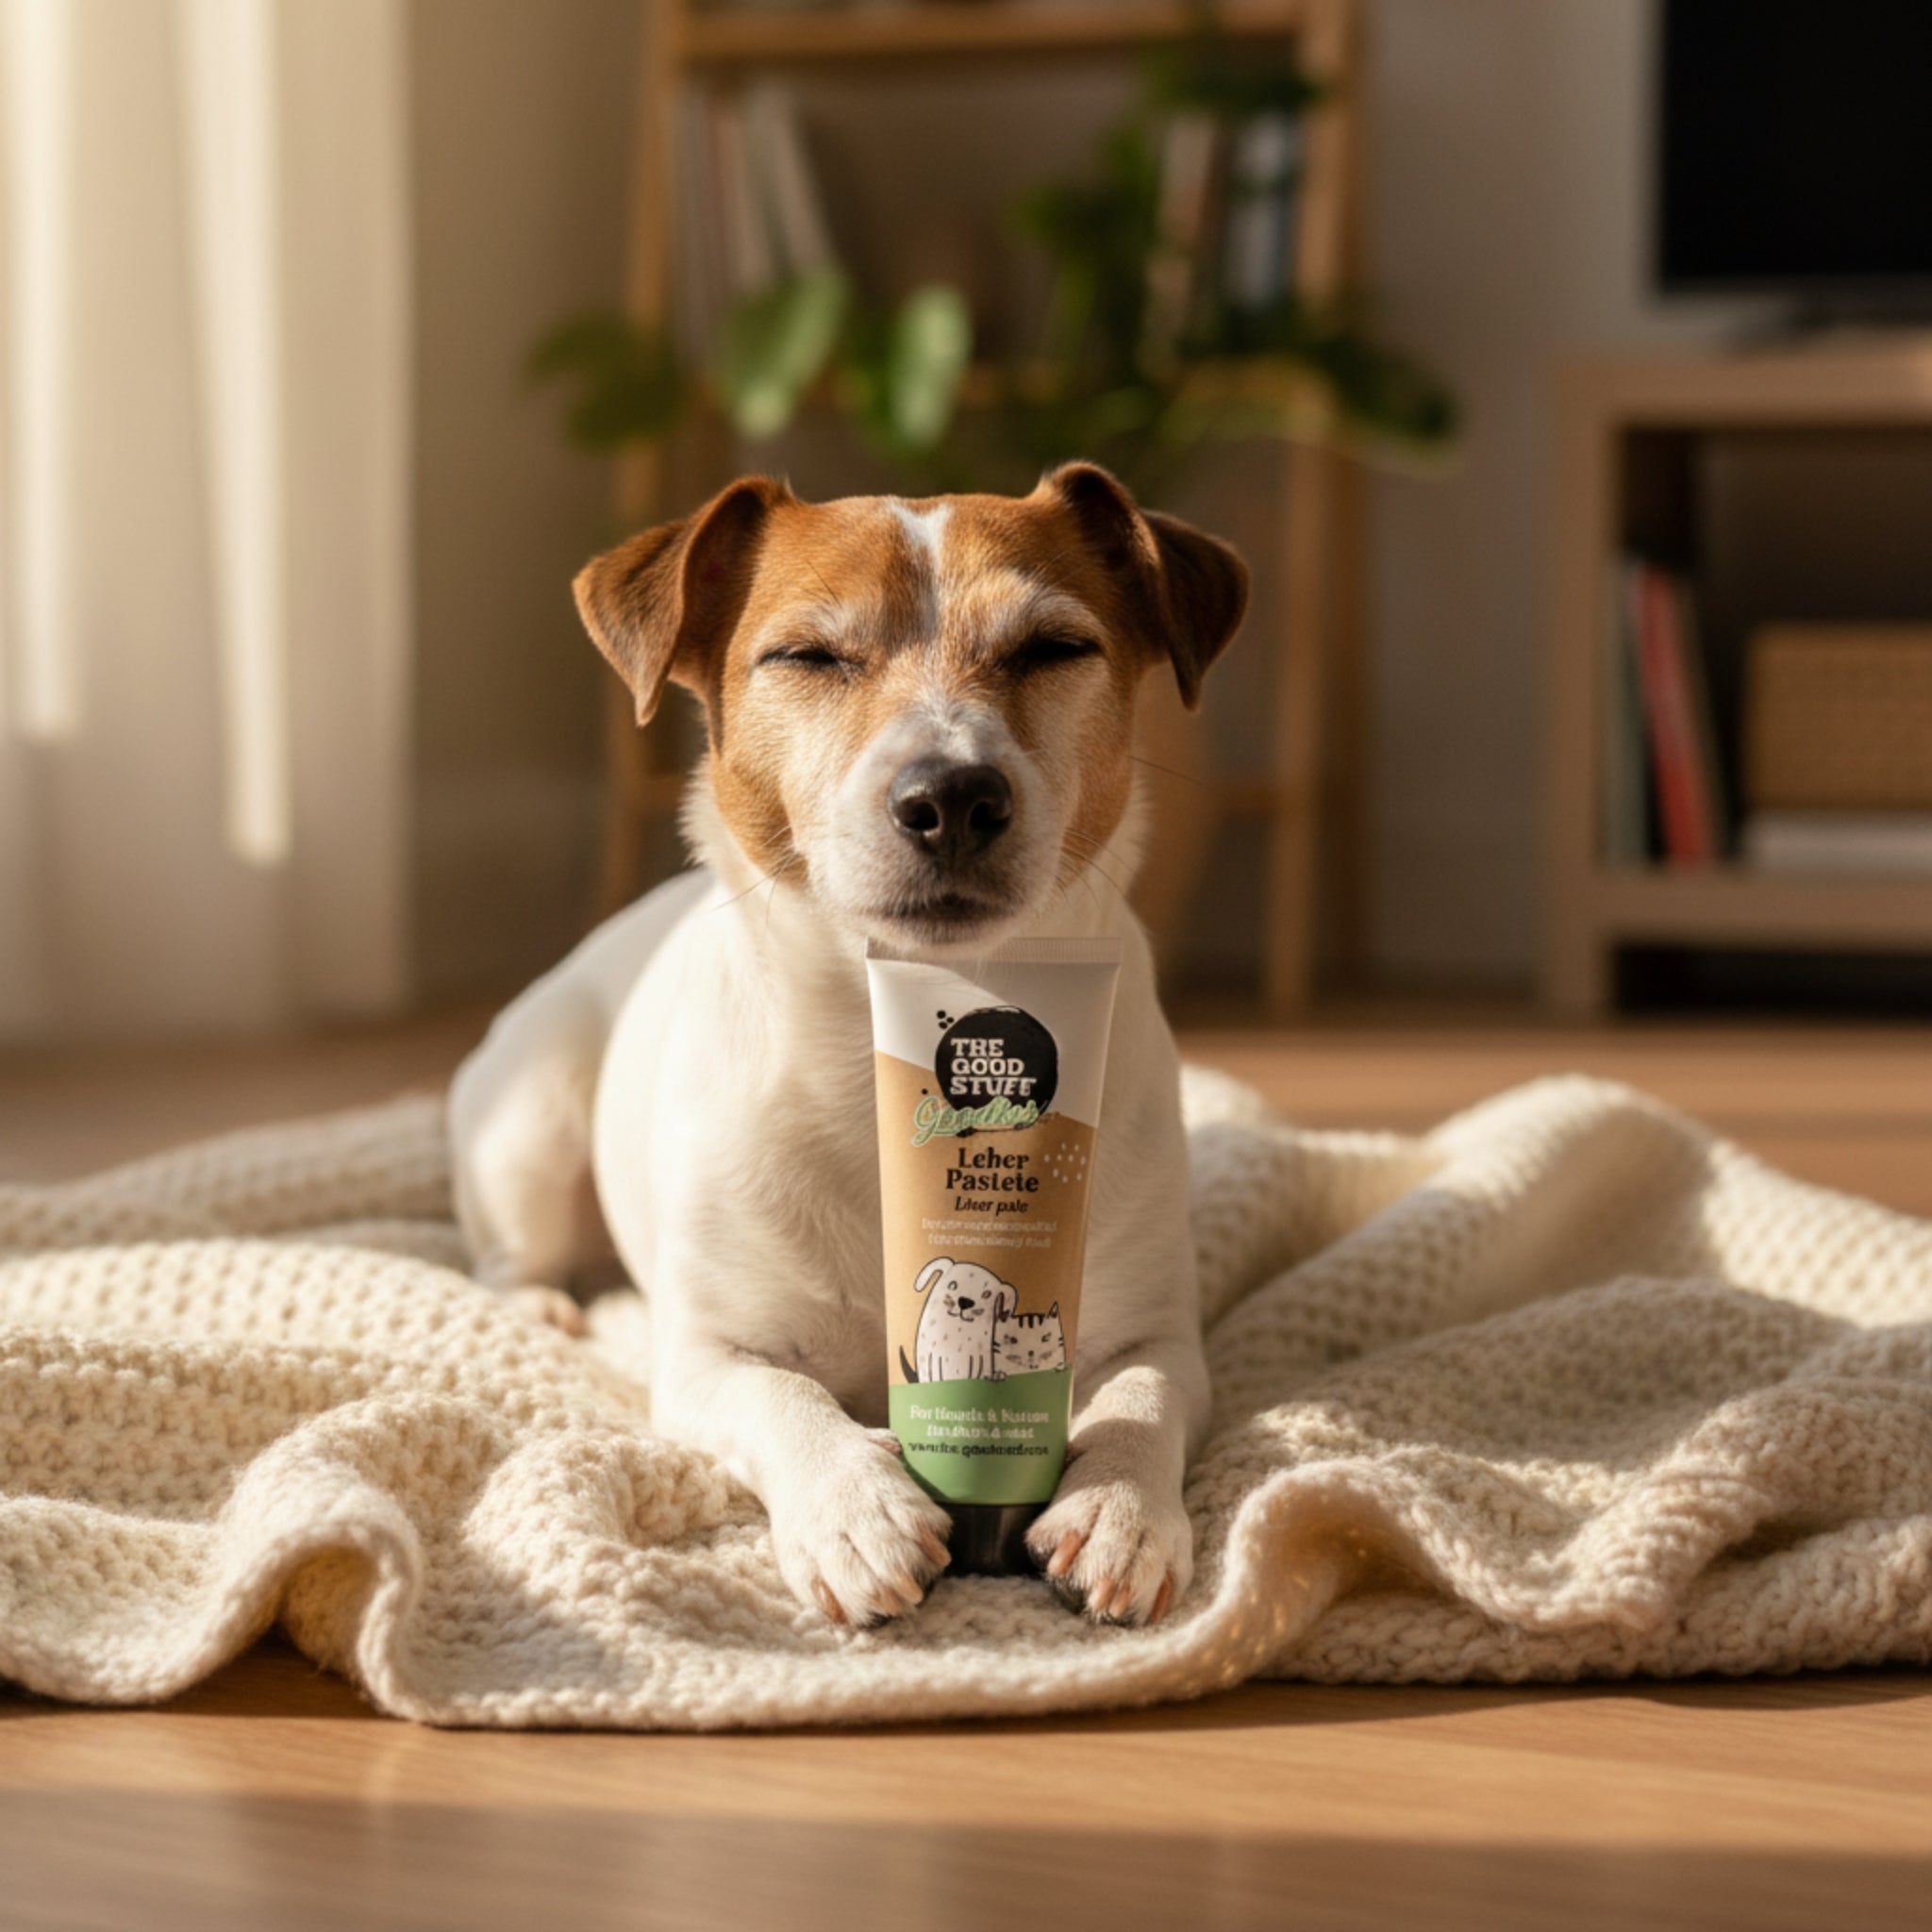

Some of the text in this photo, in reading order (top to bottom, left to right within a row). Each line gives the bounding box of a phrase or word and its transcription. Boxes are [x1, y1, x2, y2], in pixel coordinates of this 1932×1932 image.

[950, 1038, 1004, 1057] THE
[951, 1058, 1024, 1075] GOOD
[950, 1076, 1037, 1096] STUFF
